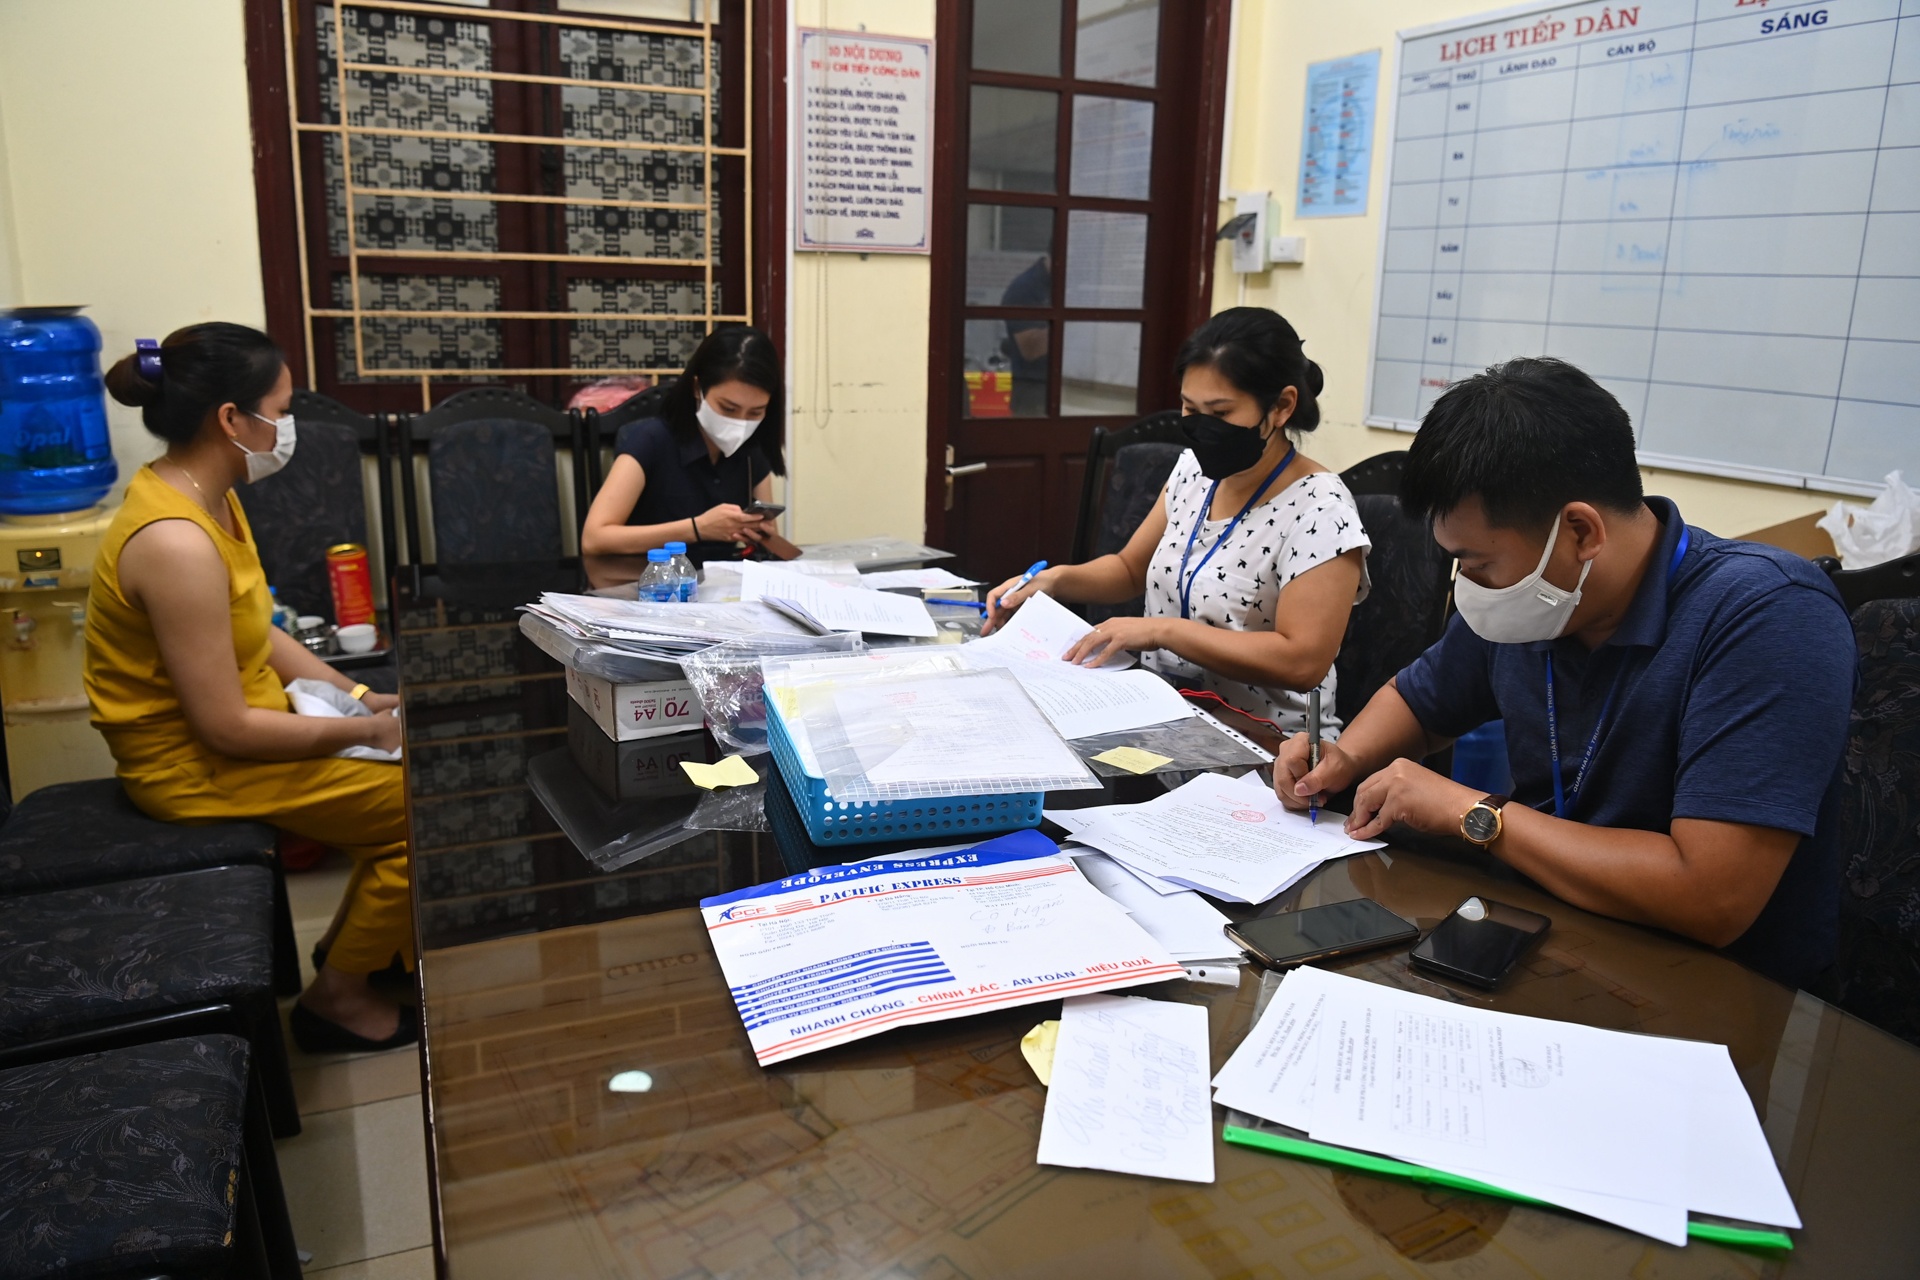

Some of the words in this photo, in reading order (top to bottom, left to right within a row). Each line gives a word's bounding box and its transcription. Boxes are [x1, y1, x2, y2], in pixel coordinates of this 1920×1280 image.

[1760, 9, 1828, 34] SÁNG
[1440, 34, 1496, 63] LỊCH
[1504, 14, 1565, 49] TIẾP
[1574, 6, 1641, 37] DÂN
[843, 43, 865, 60] NỘI
[1606, 44, 1635, 58] CÁN
[1638, 39, 1656, 53] BỘ
[634, 708, 657, 722] A4
[665, 700, 690, 718] 70
[1580, 757, 1588, 771] HAI
[894, 853, 979, 869] EXPRESS
[781, 863, 884, 889] ENVELOPE
[819, 884, 885, 904] PACIFIC
[892, 876, 962, 891] EXPRESS
[731, 907, 767, 919] PCF
[789, 1015, 847, 1036] NHANH
[850, 1000, 905, 1020] CHÓNG
[917, 989, 965, 1003] CHÍNH
[967, 982, 1000, 995] XÁC
[1011, 977, 1033, 987] AN
[1034, 970, 1076, 984] TOÀN
[1085, 962, 1119, 975] HIỆU
[1121, 955, 1153, 968] QUẢ
